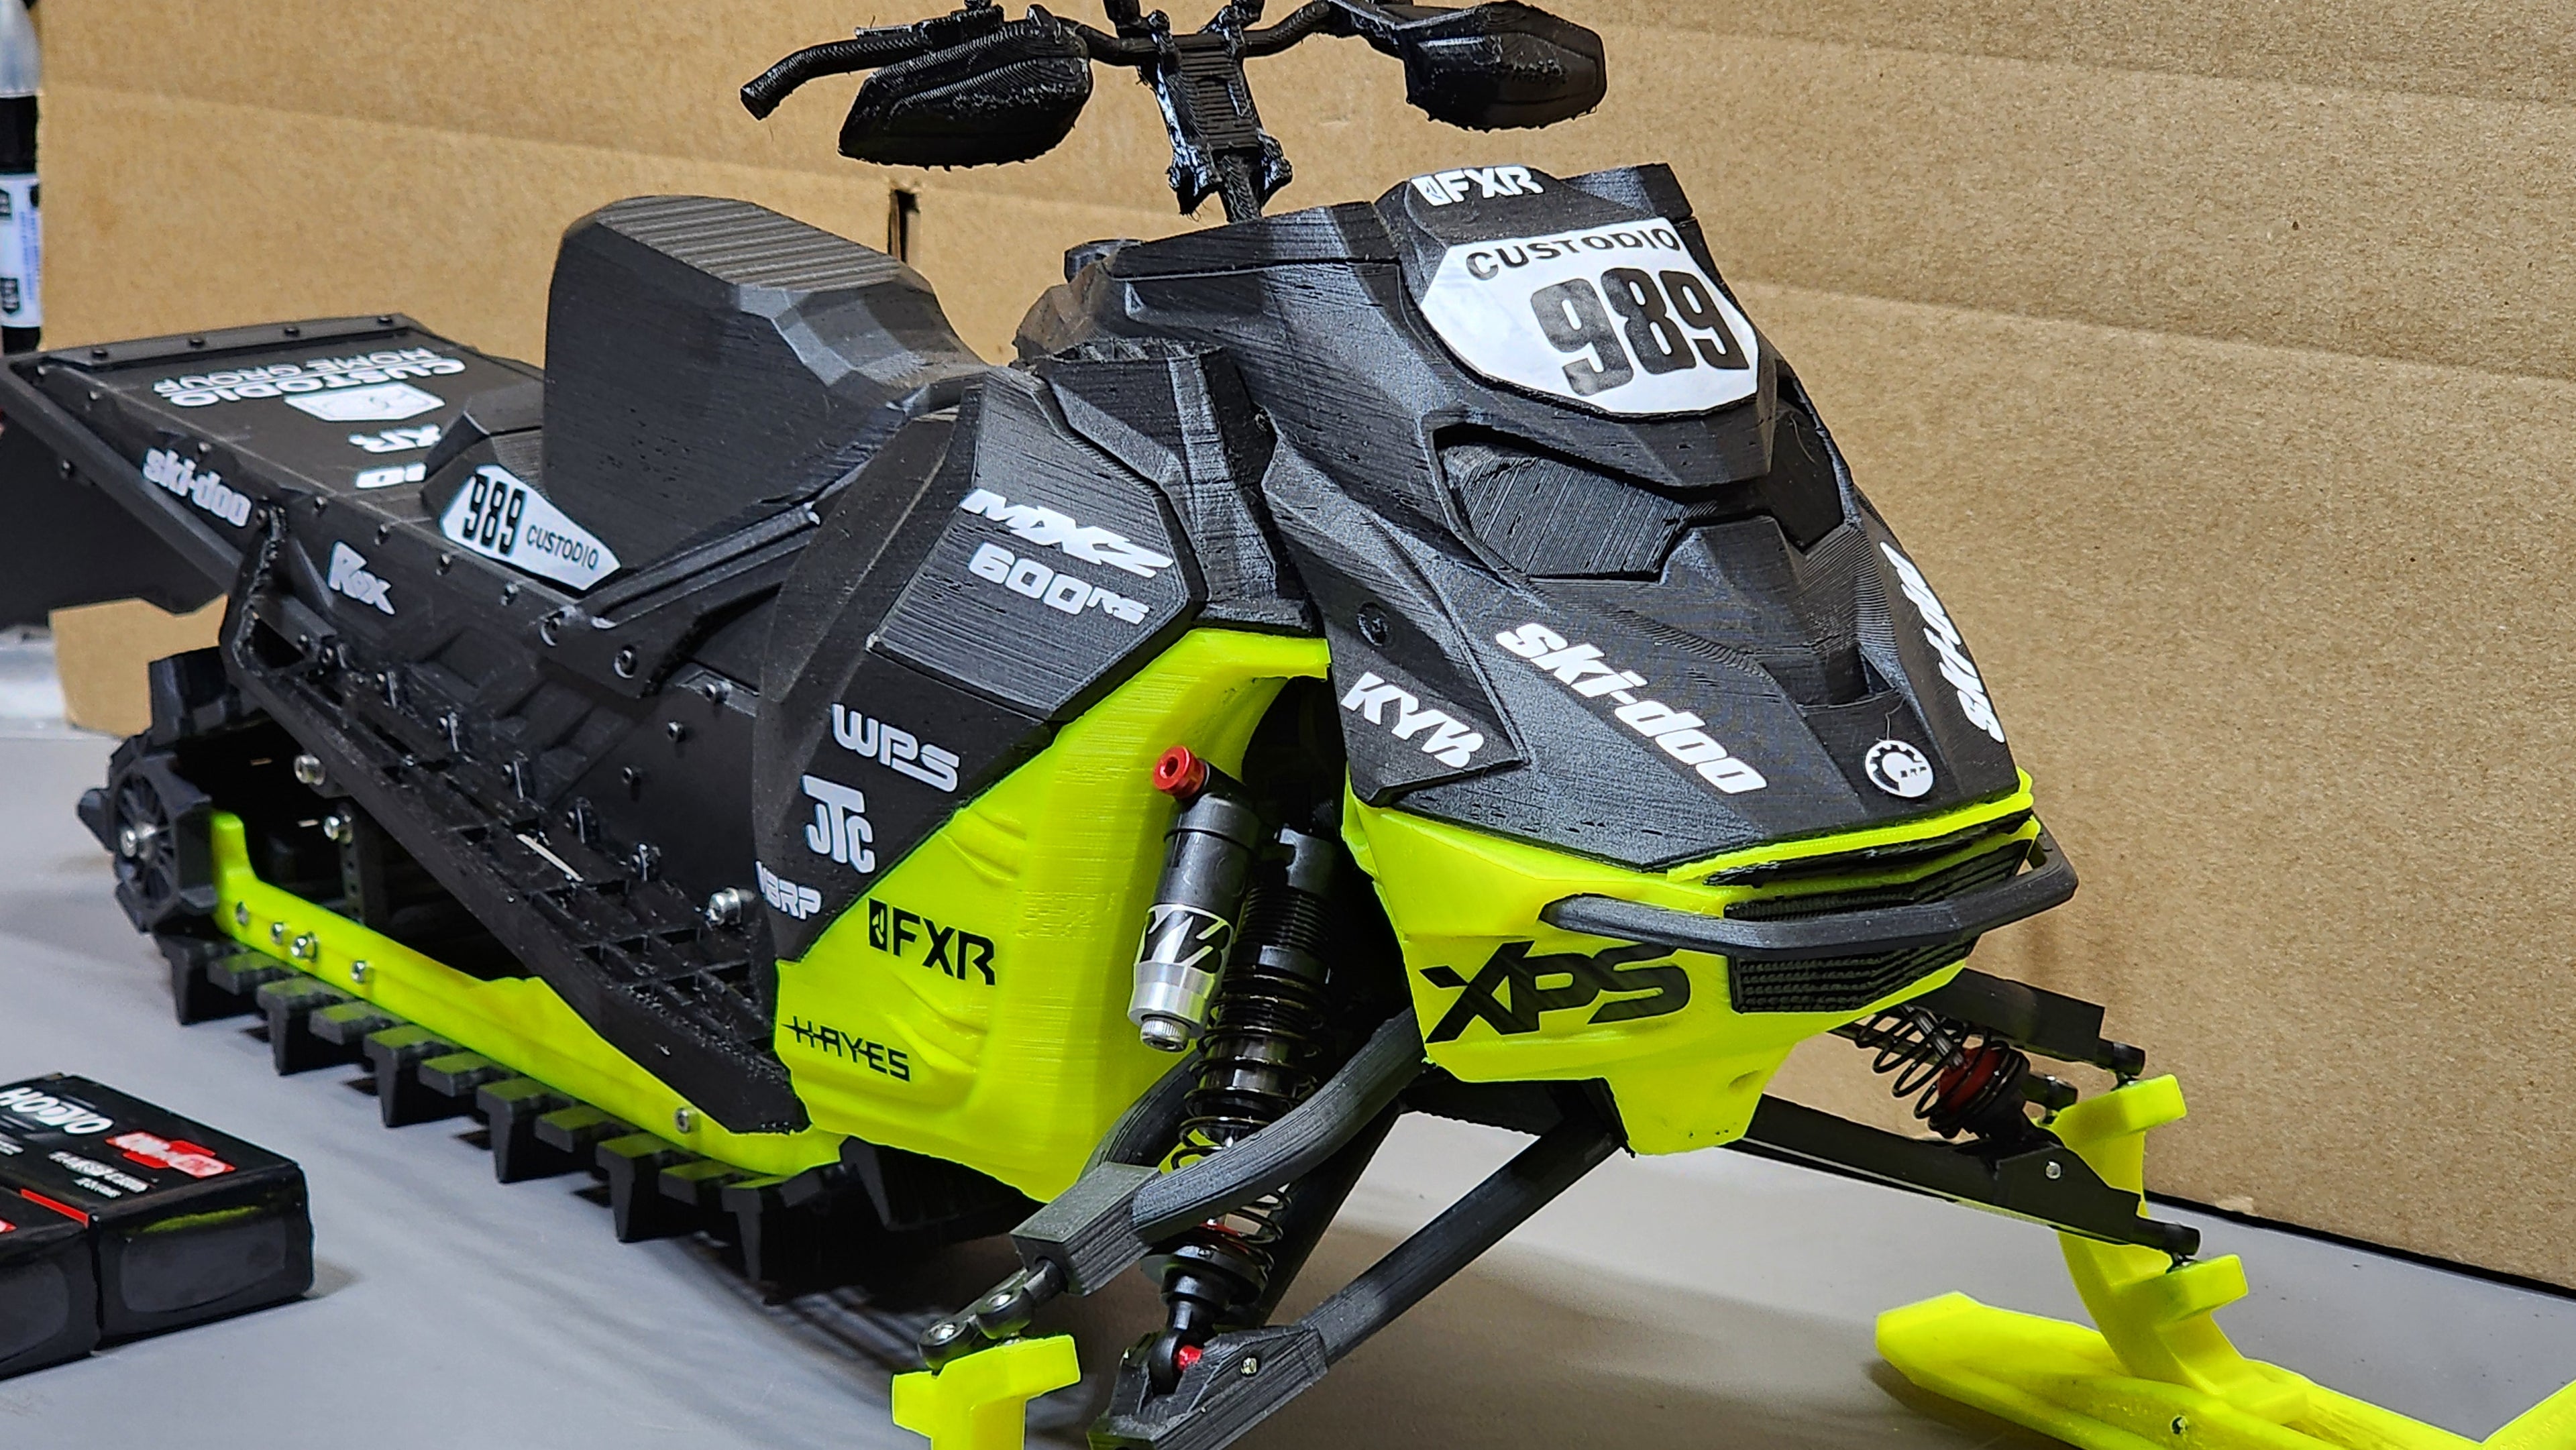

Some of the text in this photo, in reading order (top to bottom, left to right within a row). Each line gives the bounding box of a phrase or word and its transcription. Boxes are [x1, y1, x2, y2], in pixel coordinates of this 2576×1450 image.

[1444, 166, 1543, 203] FXR
[1466, 228, 1681, 280] CUSTODIO
[153, 347, 437, 395] HOME GROUP
[1530, 267, 1750, 396] 989
[170, 358, 466, 407] CUSTODIO
[143, 449, 252, 528] ski-doo
[462, 473, 527, 555] 989
[526, 524, 599, 570] CUSTODIO
[959, 488, 1174, 578] MXZ
[1495, 622, 1768, 794] ski-doo
[831, 704, 960, 793] WPS
[802, 774, 875, 874] JTC
[892, 906, 996, 986] FXR
[1419, 940, 1691, 1044] XPS
[780, 1015, 910, 1082] HAYES
